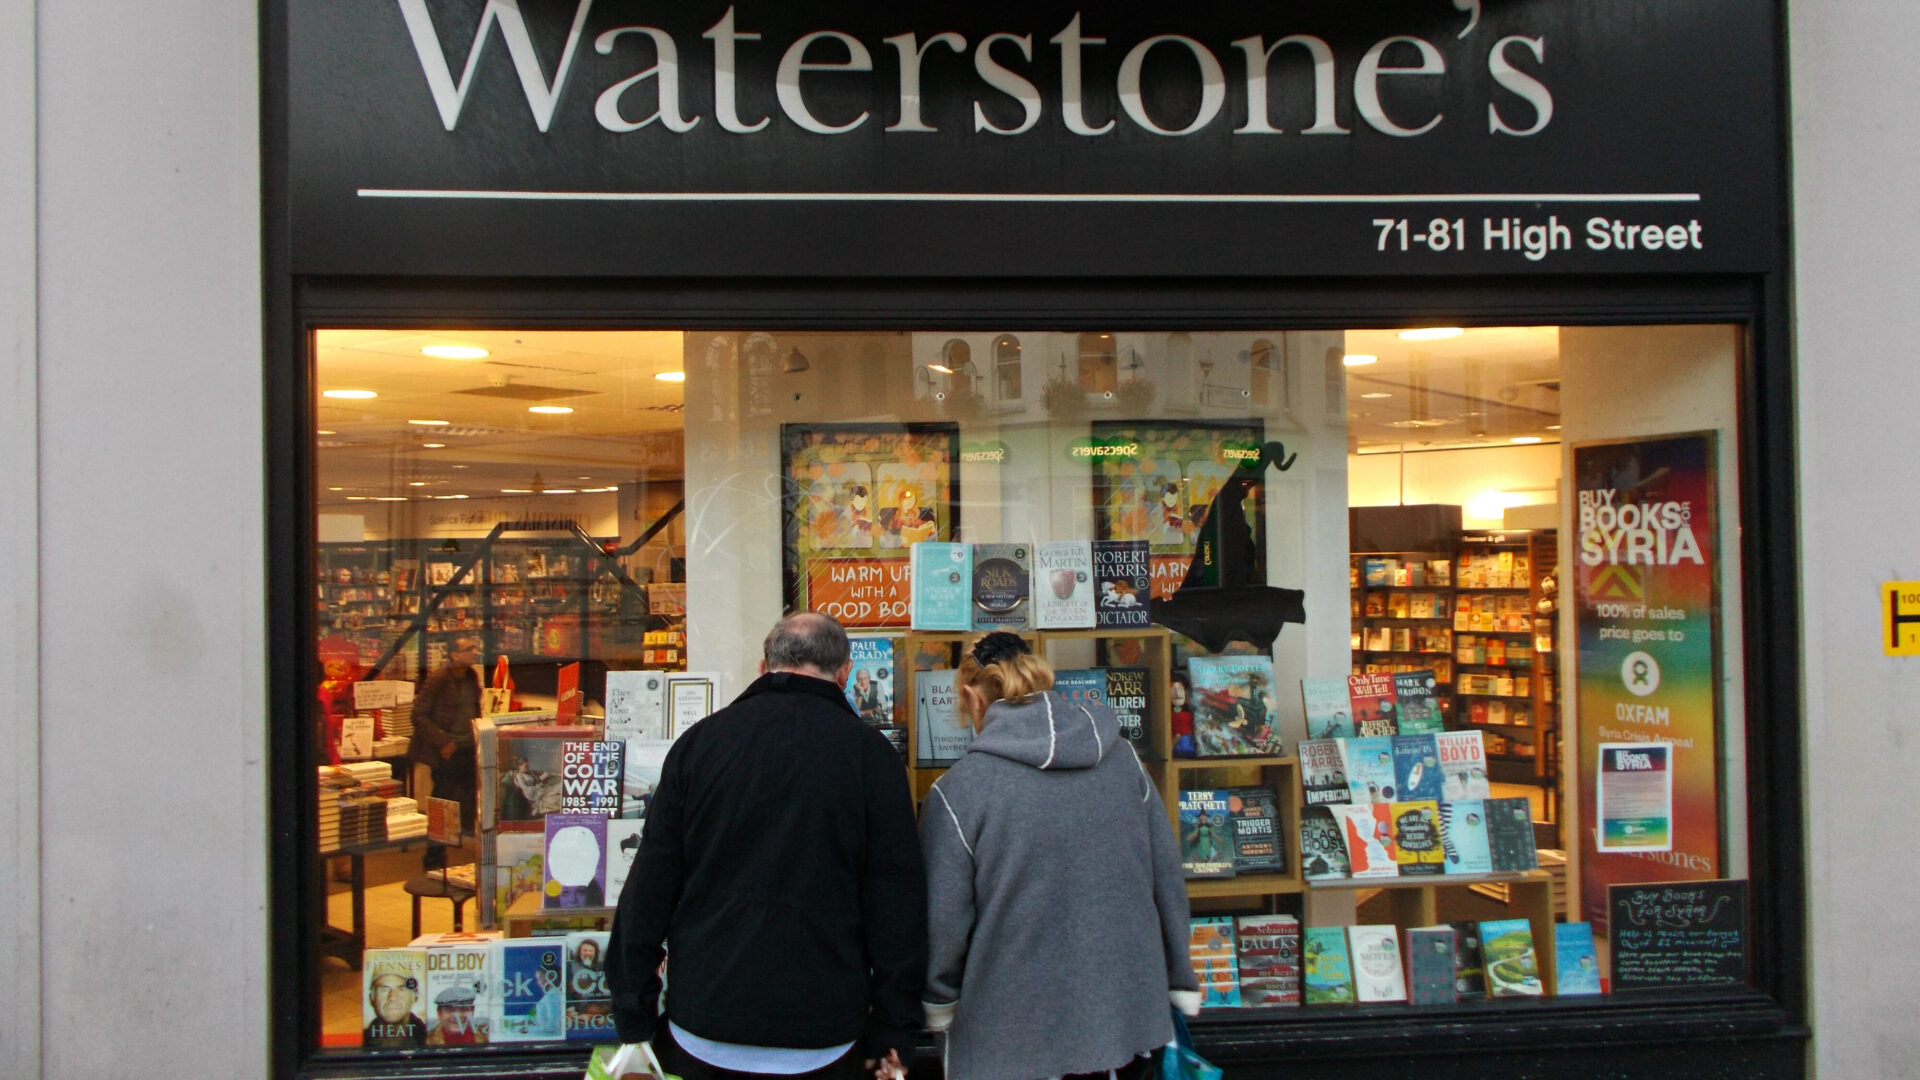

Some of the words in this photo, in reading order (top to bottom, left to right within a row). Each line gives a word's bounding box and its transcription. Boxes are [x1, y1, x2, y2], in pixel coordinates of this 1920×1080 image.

[398, 0, 1554, 137] Waterstone's
[1372, 218, 1465, 251] 71-81
[1483, 215, 1571, 261] High
[1586, 217, 1703, 250] Street
[1579, 489, 1616, 508] BUY
[429, 514, 459, 525] Science
[1579, 501, 1682, 531] BOOKS
[1681, 501, 1691, 528] FOR
[1580, 528, 1704, 566] SYRIA
[1040, 557, 1087, 569] MARTIN
[1094, 551, 1148, 564] ROBERT
[831, 565, 883, 583] WARM
[985, 567, 1012, 578] SILK
[1094, 564, 1148, 577] HARRIS
[981, 578, 1017, 590] ROADS
[1162, 581, 1182, 593] WIT
[851, 585, 884, 598] WITH
[889, 585, 897, 597] A
[879, 601, 911, 618] BO
[1597, 604, 1630, 618] 100%
[1632, 605, 1646, 618] of
[1649, 605, 1686, 620] sales
[1095, 611, 1148, 624] DICTATOR
[1600, 625, 1630, 640] price
[1632, 630, 1666, 643] goes
[1668, 629, 1685, 641] to
[852, 641, 877, 650] PAUL
[850, 651, 888, 660] GRADY
[1106, 672, 1144, 681] NDREW
[1348, 677, 1371, 688] Only
[1371, 674, 1390, 683] Time
[1396, 678, 1420, 687] MARK
[1353, 686, 1371, 695] Will
[1374, 684, 1388, 693] Tell
[1397, 687, 1432, 696] HADDON
[1107, 696, 1146, 708] ILDREN
[1117, 715, 1141, 727] STER
[1615, 703, 1670, 727] OXFAM
[1361, 719, 1391, 728] JEFFREY
[1360, 727, 1396, 737] ARCHER
[1598, 726, 1622, 740] Syria
[565, 742, 590, 752] THE
[593, 742, 620, 751] END
[1438, 736, 1478, 746] WILLIAM
[564, 752, 585, 764] OF
[591, 752, 620, 764] THE
[1440, 746, 1481, 762] BOYD
[1302, 757, 1343, 769] HARRIS
[1616, 760, 1653, 771] SYRIA
[564, 764, 618, 779] COLD
[563, 779, 618, 796] WAR
[1187, 792, 1214, 801] TERRY
[1306, 788, 1350, 805] IMPERIUM
[1178, 800, 1227, 810] PRATCHETT
[1237, 818, 1271, 827] TRIGGER
[1237, 826, 1272, 835] MORTIS
[1256, 926, 1298, 934] Sebastian
[1241, 937, 1298, 950] FAULKS
[428, 953, 456, 971] DEL
[456, 952, 486, 970] BOY
[371, 1024, 416, 1037] HEAT
